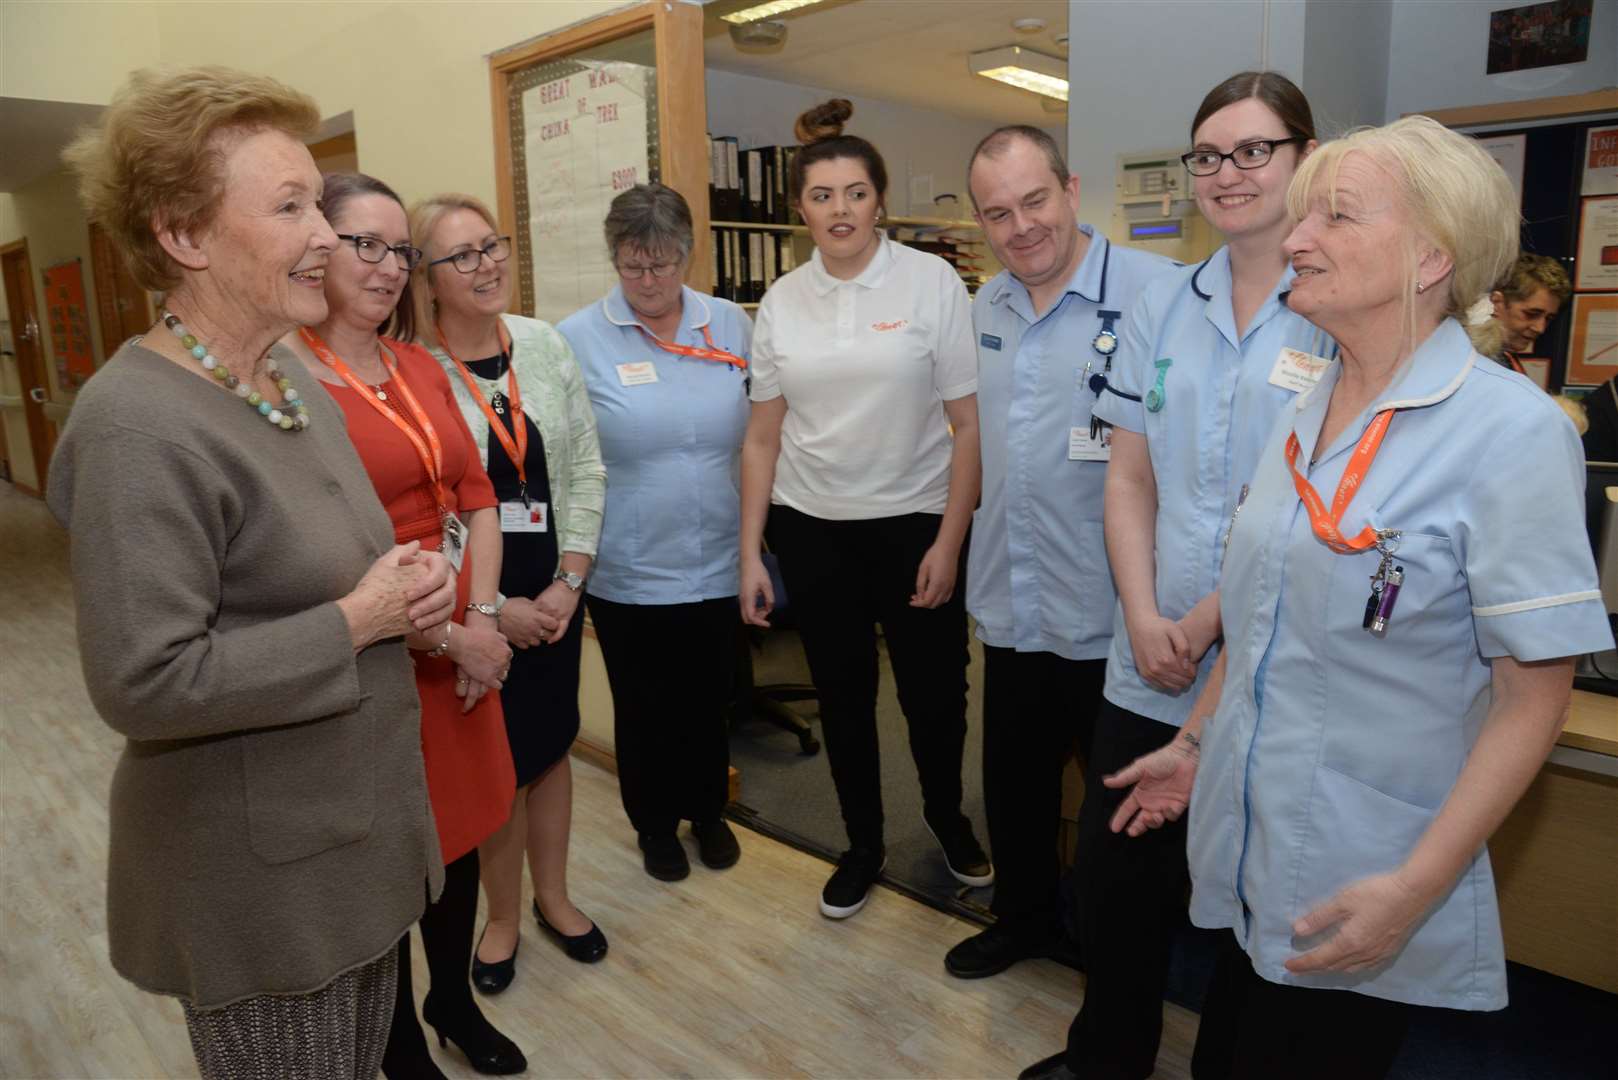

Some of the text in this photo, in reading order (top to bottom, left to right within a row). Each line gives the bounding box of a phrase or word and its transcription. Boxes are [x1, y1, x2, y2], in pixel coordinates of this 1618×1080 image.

[540, 79, 570, 104] GREAT
[541, 103, 619, 141] CHINA TREK
